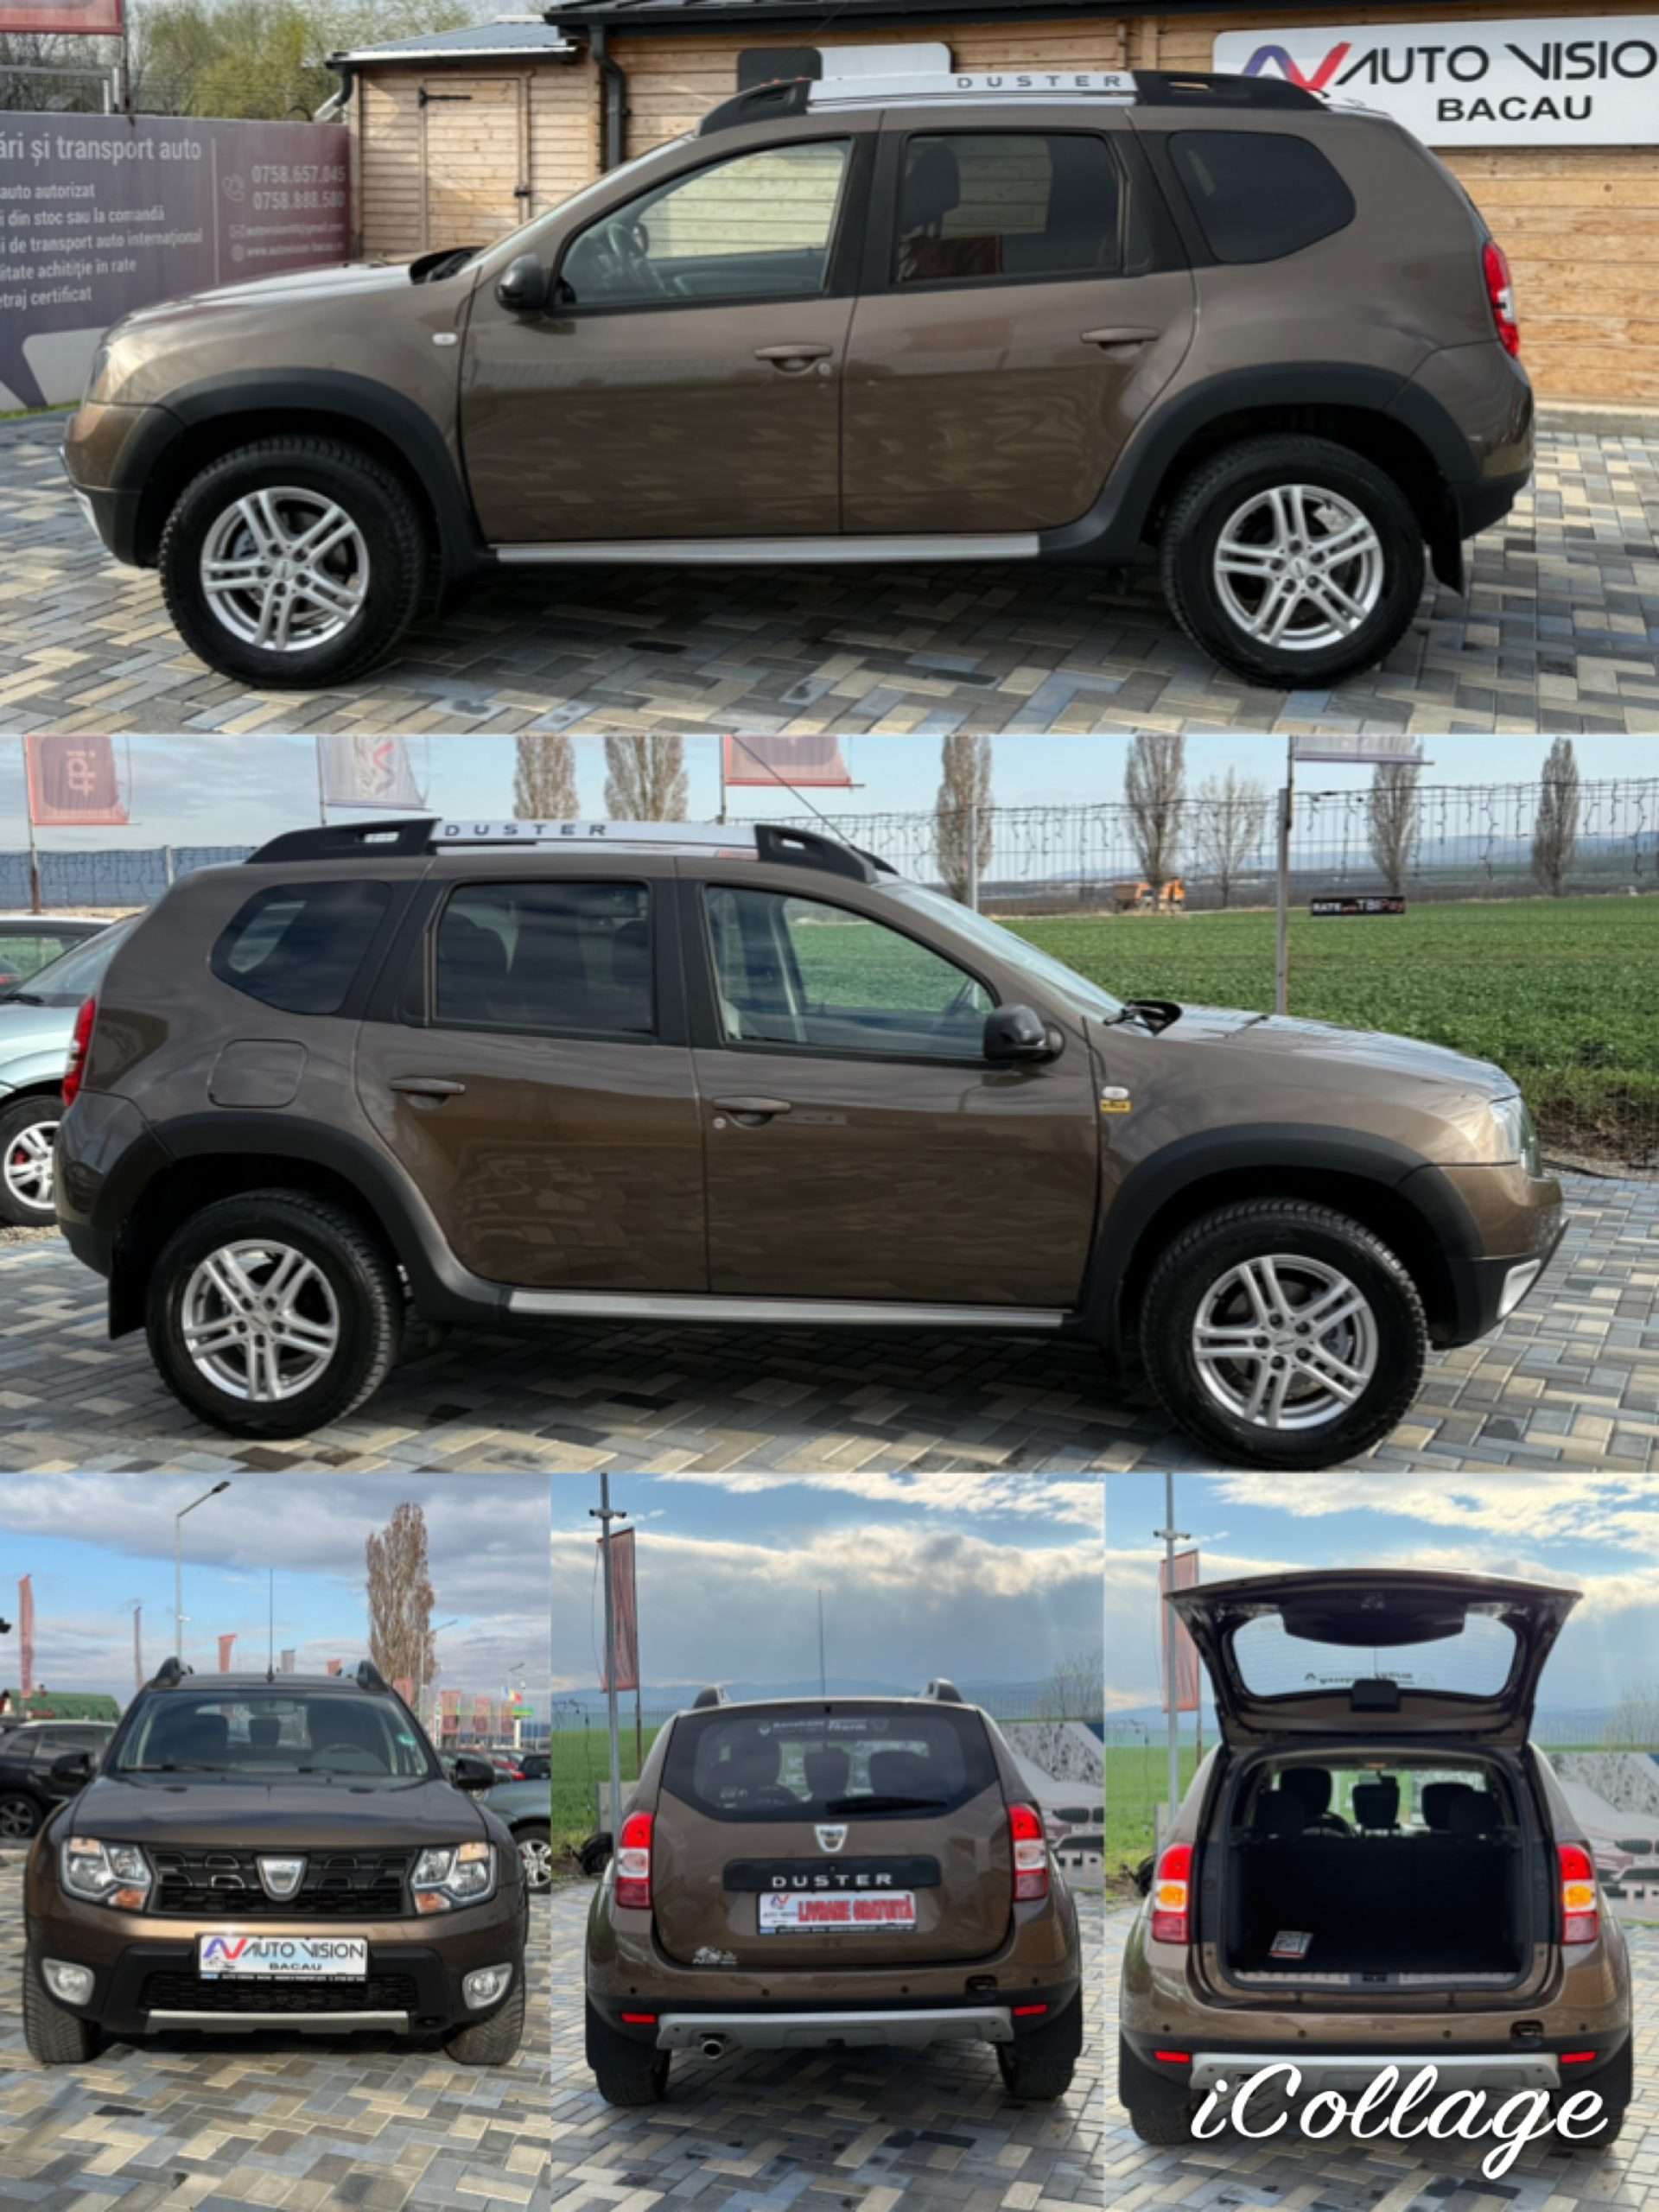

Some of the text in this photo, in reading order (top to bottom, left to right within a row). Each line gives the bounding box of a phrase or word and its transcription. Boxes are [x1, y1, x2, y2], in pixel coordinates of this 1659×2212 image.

[1336, 46, 1490, 85] AUTO
[957, 75, 1121, 88] DUSTER
[1437, 96, 1592, 122] BACAU
[56, 136, 155, 166] transport
[160, 137, 202, 160] auto
[35, 181, 95, 200] autorizat
[35, 211, 63, 226] stoc
[9, 236, 27, 253] de
[30, 234, 92, 255] transport
[444, 824, 606, 836] DUSTER
[772, 1873, 893, 1889] DUSTER
[242, 1942, 296, 1958] AUTO
[300, 1942, 365, 1958] VISION
[269, 1962, 322, 1971] BACAU
